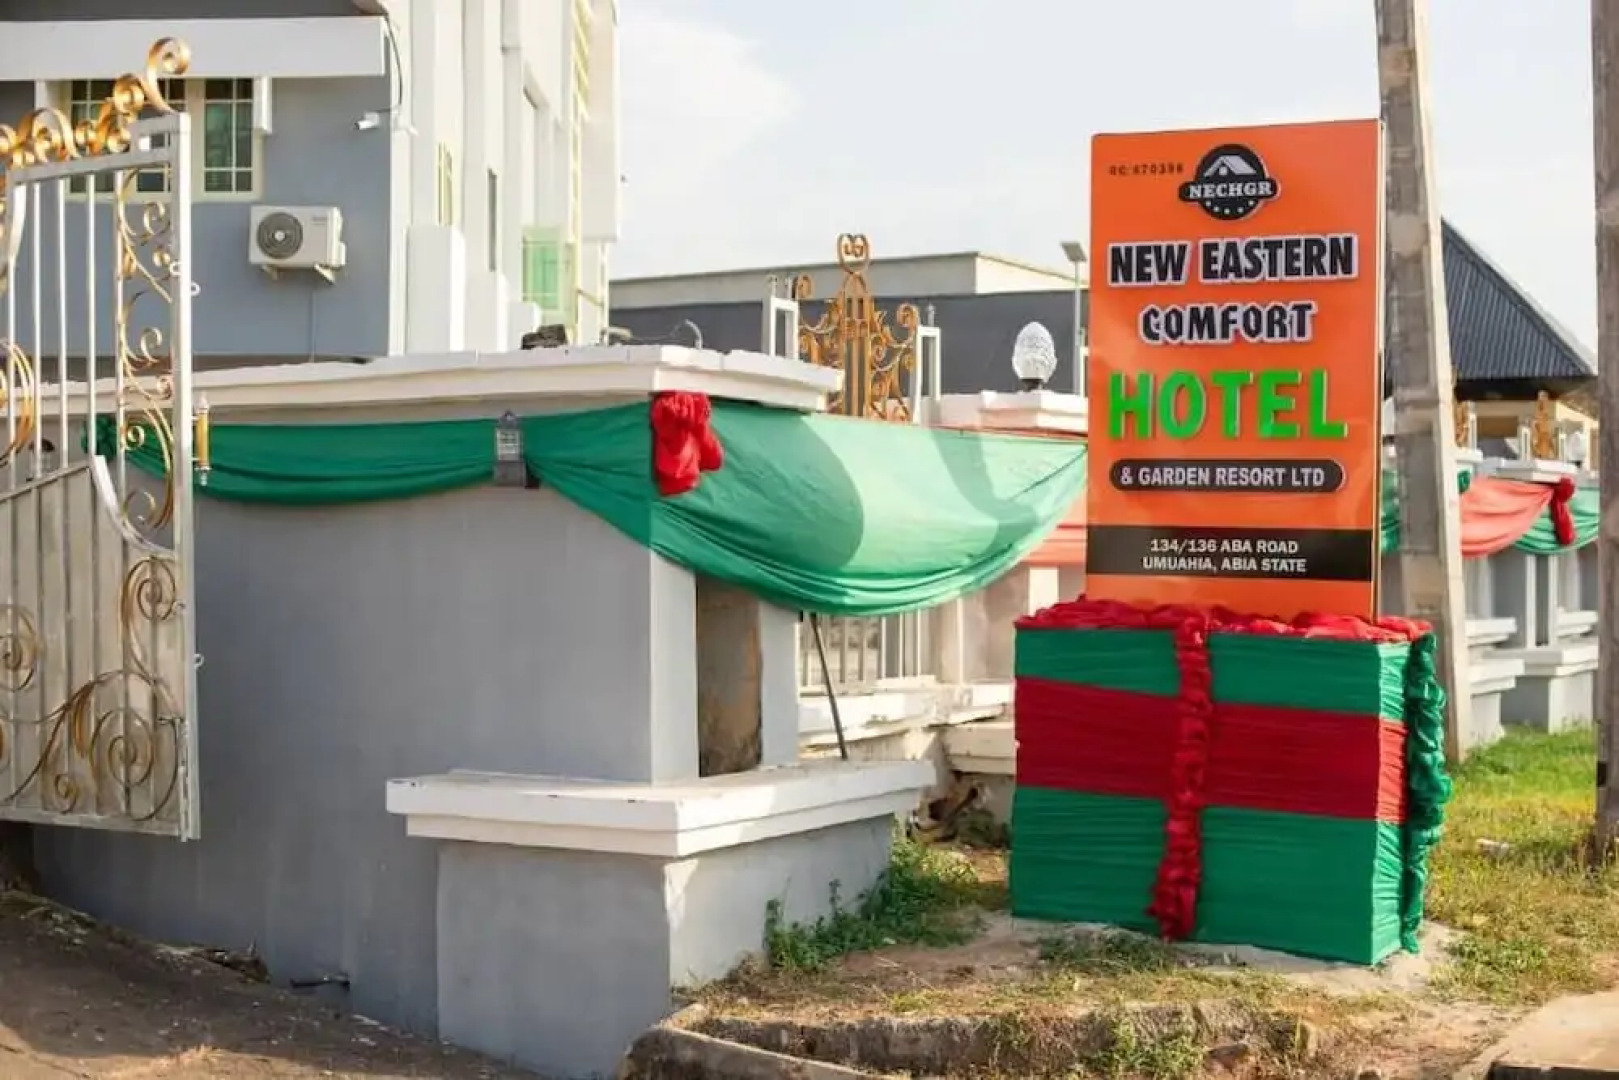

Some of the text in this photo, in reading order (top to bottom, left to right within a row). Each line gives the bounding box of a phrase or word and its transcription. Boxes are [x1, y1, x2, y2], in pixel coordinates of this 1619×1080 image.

[1189, 181, 1273, 199] NECHGR
[1109, 235, 1357, 285] NEW EASTERN
[1140, 301, 1316, 342] COMFORT
[1108, 368, 1348, 440] HOTEL
[1120, 466, 1325, 486] & GARDEN RESORT LTD
[1150, 538, 1298, 554] 134/136 ABA ROAD
[1142, 556, 1307, 573] UMUAHIA, ABIA STATE
